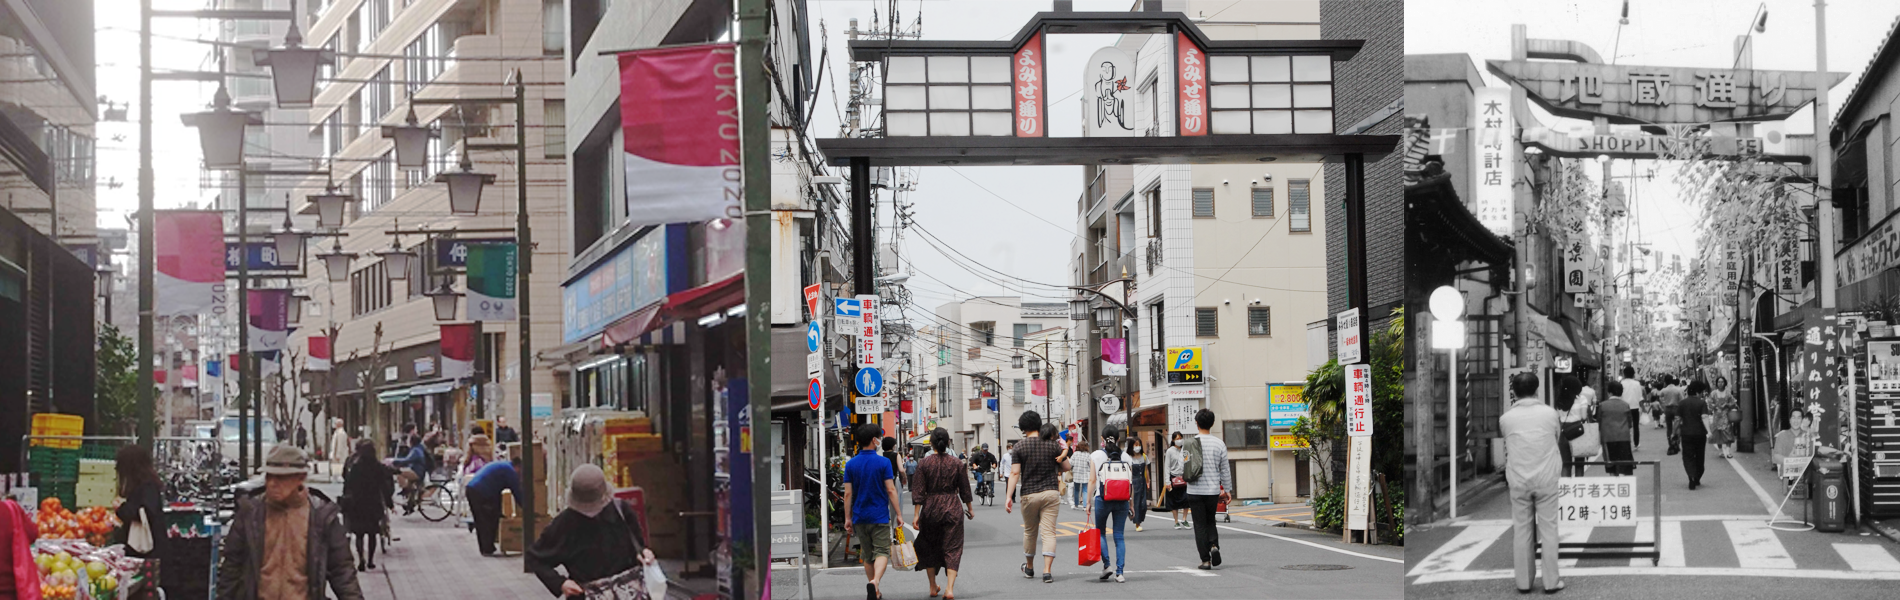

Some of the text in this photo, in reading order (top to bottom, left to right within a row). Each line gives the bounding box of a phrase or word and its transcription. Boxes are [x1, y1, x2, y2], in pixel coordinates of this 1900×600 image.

[1018, 48, 1037, 135] よみせ通り
[1183, 47, 1202, 133] よみせ通り
[1560, 71, 1786, 108] 地蔵通り
[1558, 483, 1630, 498] 歩行者天国
